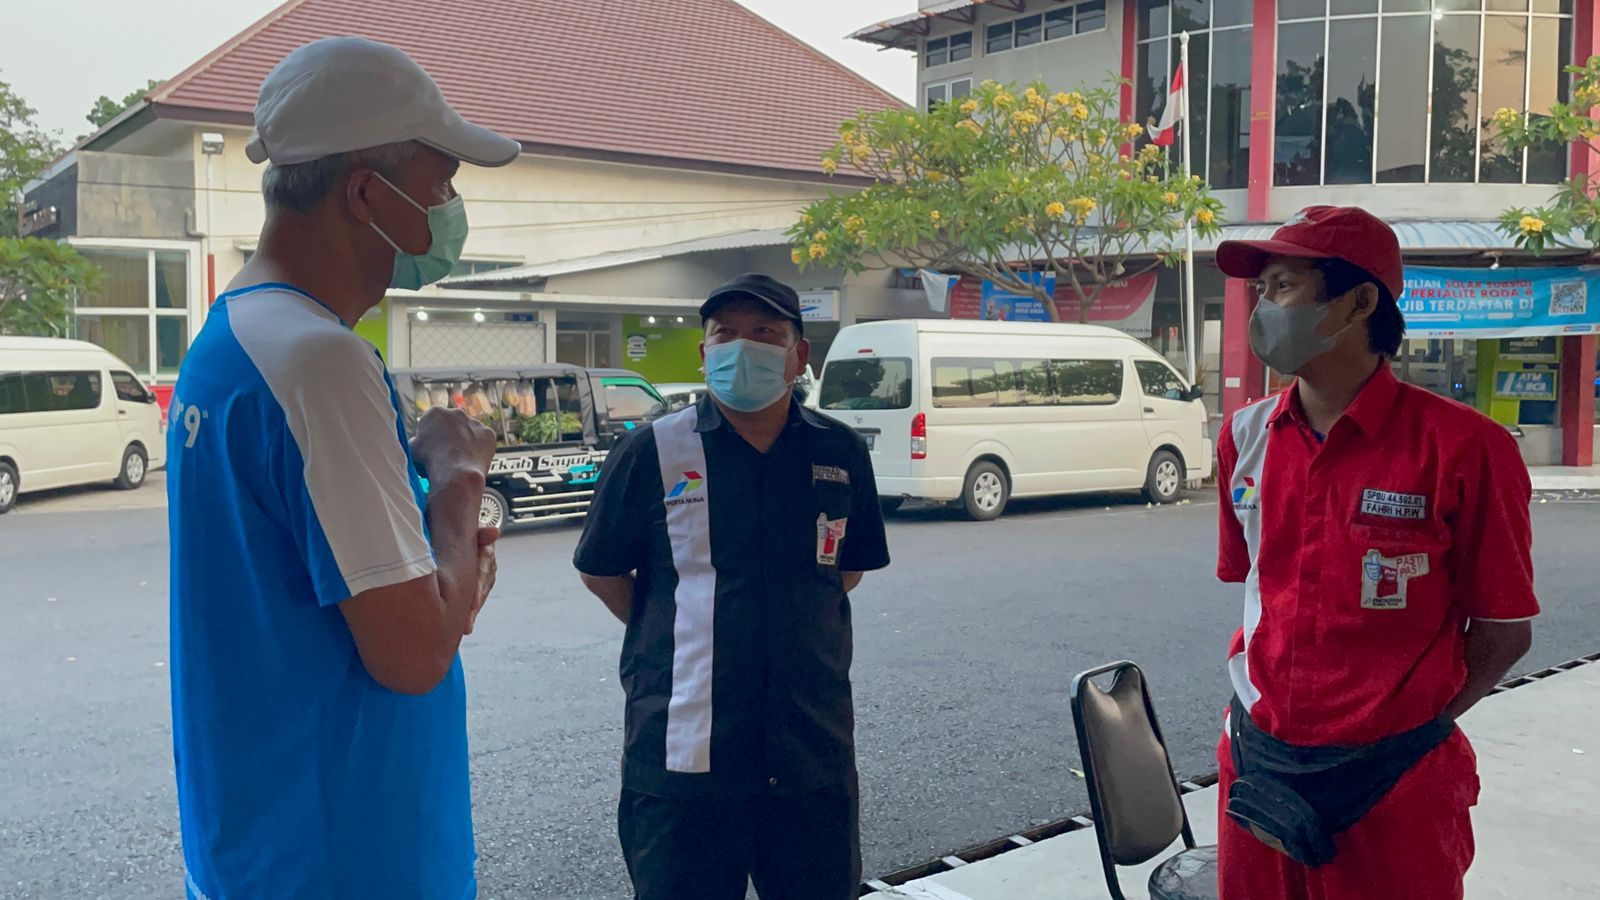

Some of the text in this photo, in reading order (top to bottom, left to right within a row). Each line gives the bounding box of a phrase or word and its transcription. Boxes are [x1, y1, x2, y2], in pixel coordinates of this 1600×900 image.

[1445, 280, 1482, 289] SOLAR
[1410, 288, 1476, 299] PERTALITE
[1480, 288, 1519, 298] RODA
[1397, 298, 1534, 312] JIB TERDAFTAR DI
[1519, 372, 1542, 381] ATM
[489, 454, 590, 473] rkah Sayur
[1367, 490, 1386, 502] SPBU
[1366, 503, 1393, 515] FAHRI
[1396, 554, 1424, 569] PASTI
